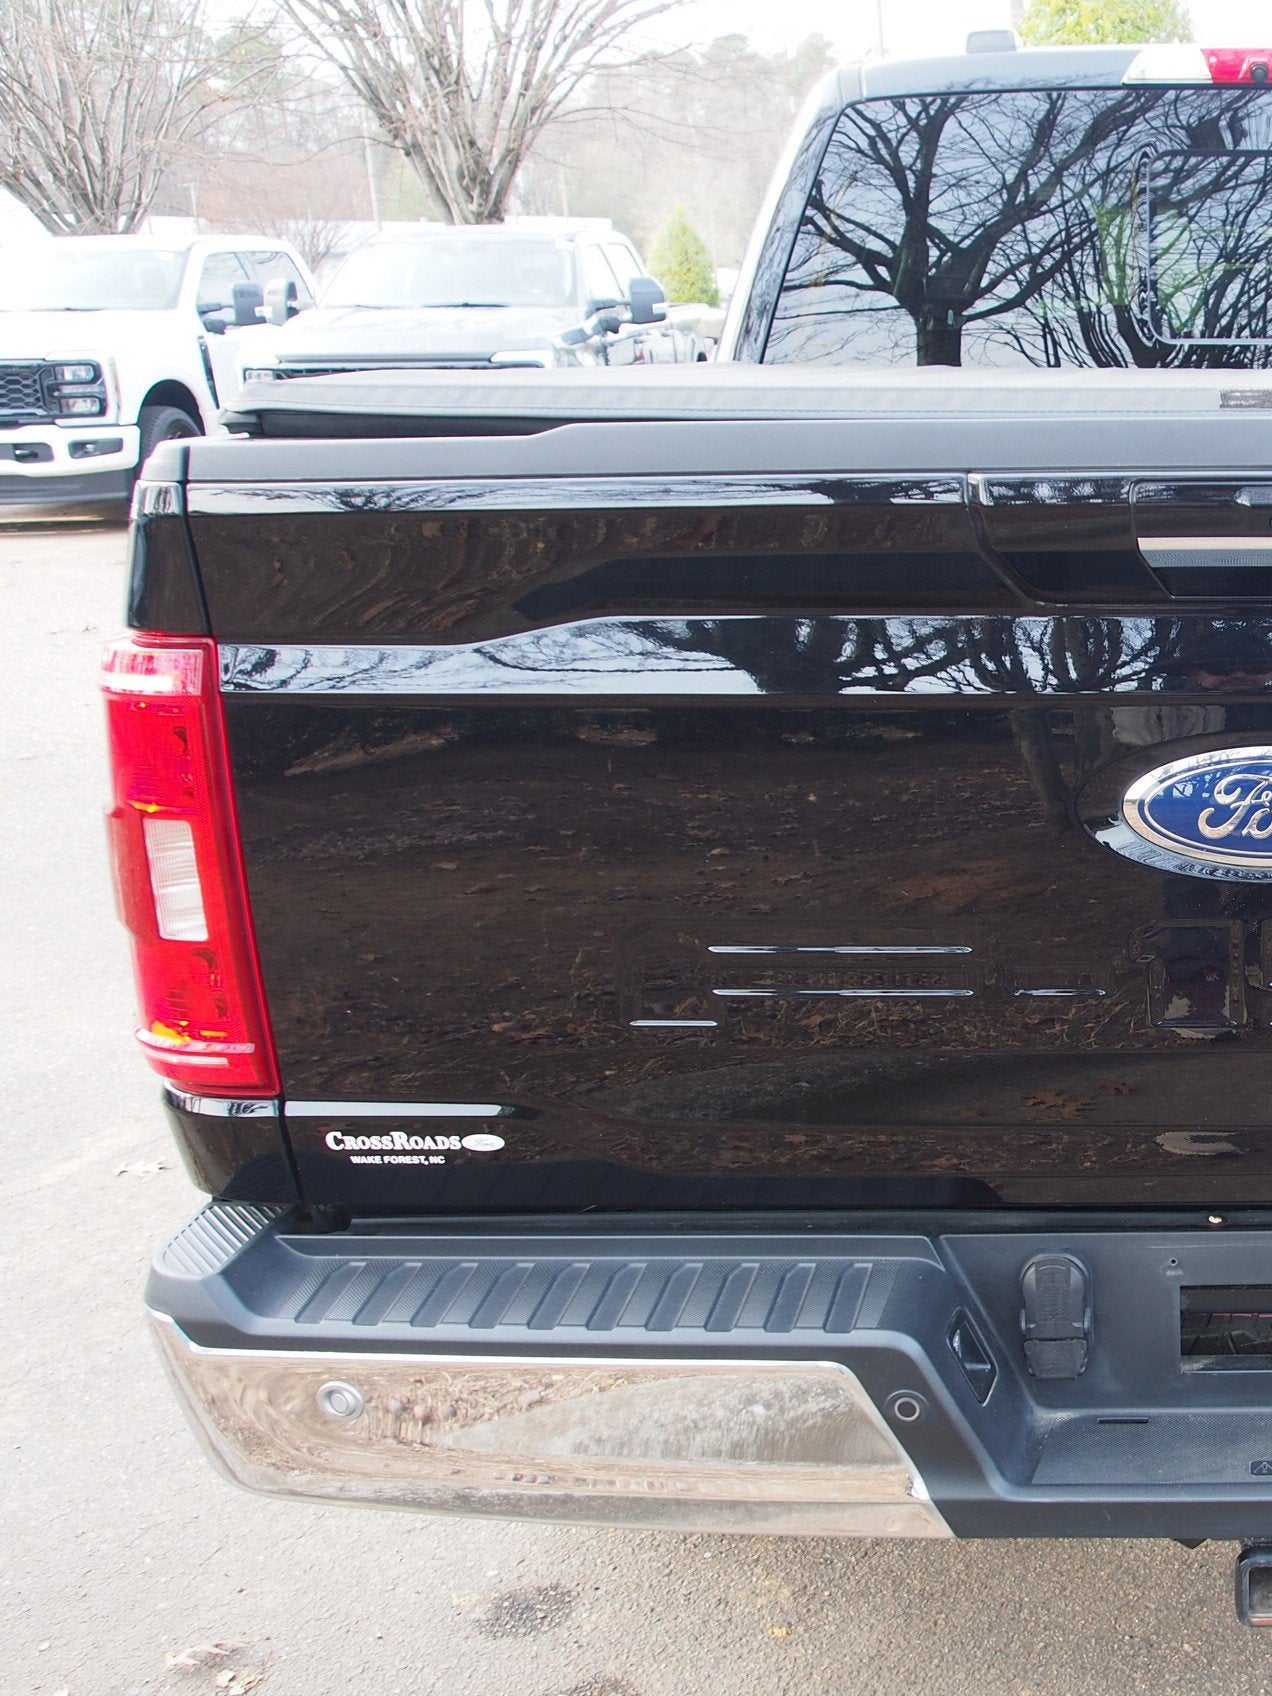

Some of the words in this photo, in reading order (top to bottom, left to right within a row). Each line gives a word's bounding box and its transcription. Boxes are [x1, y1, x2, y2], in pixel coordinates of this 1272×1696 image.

[349, 1155, 382, 1164] WAKE
[383, 1155, 429, 1165] FOREST,
[429, 1155, 446, 1164] NC
